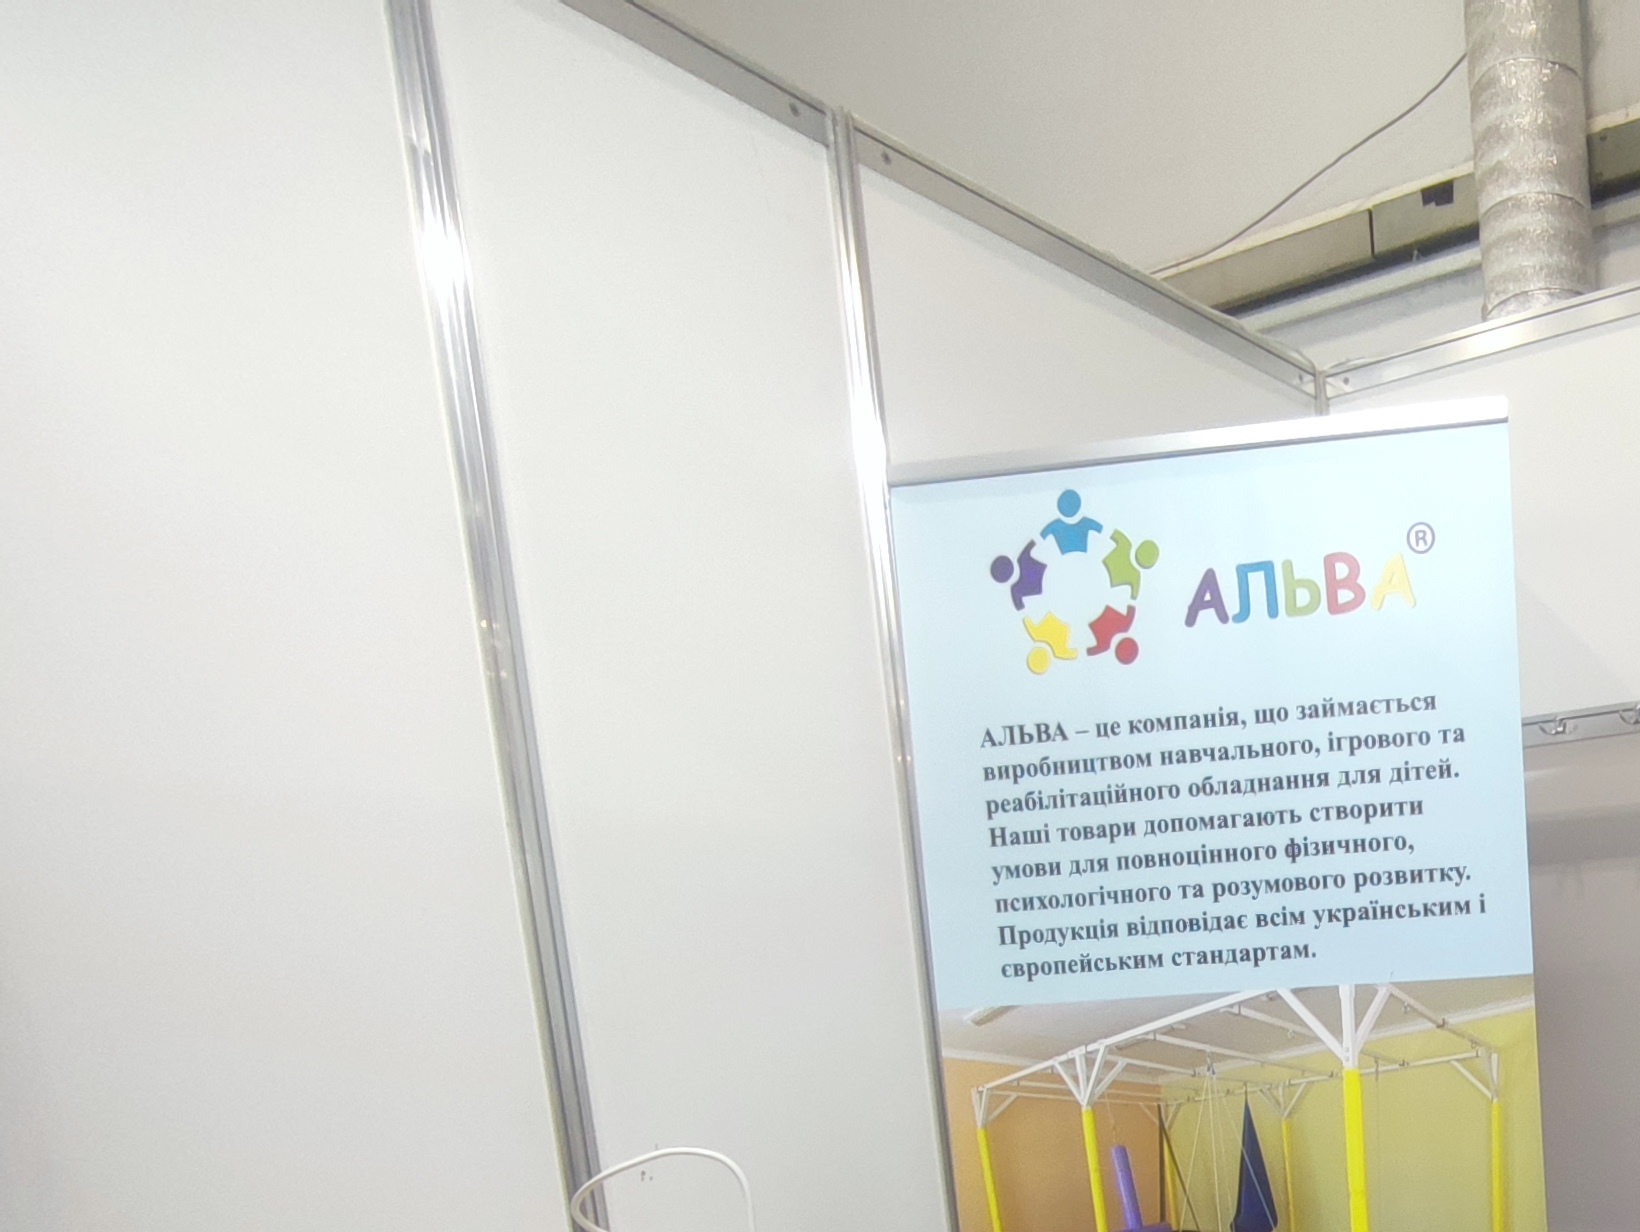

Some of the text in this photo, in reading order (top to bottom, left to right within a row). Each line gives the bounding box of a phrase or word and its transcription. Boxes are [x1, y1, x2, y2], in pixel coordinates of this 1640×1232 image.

[1184, 551, 1417, 628] АЛЬВА
[980, 721, 1069, 748] АЛЬВА
[1095, 720, 1121, 739] це
[1128, 705, 1247, 736] компанія,
[1253, 705, 1289, 725] що
[1295, 694, 1437, 721] займається
[983, 726, 1465, 785] виробництвом навчального, ігрового та
[986, 757, 1460, 820] реабілітаційного обладнання для дітей.
[988, 799, 1424, 848] Наші товари допомагають створити
[991, 834, 1415, 886] умови для повноцінного фізичного,
[994, 865, 1471, 913] психологічного та розумового розвитку.
[998, 893, 1487, 949] Продукція відповідає всім українським і
[1001, 943, 1317, 981] європейським стандартам.
